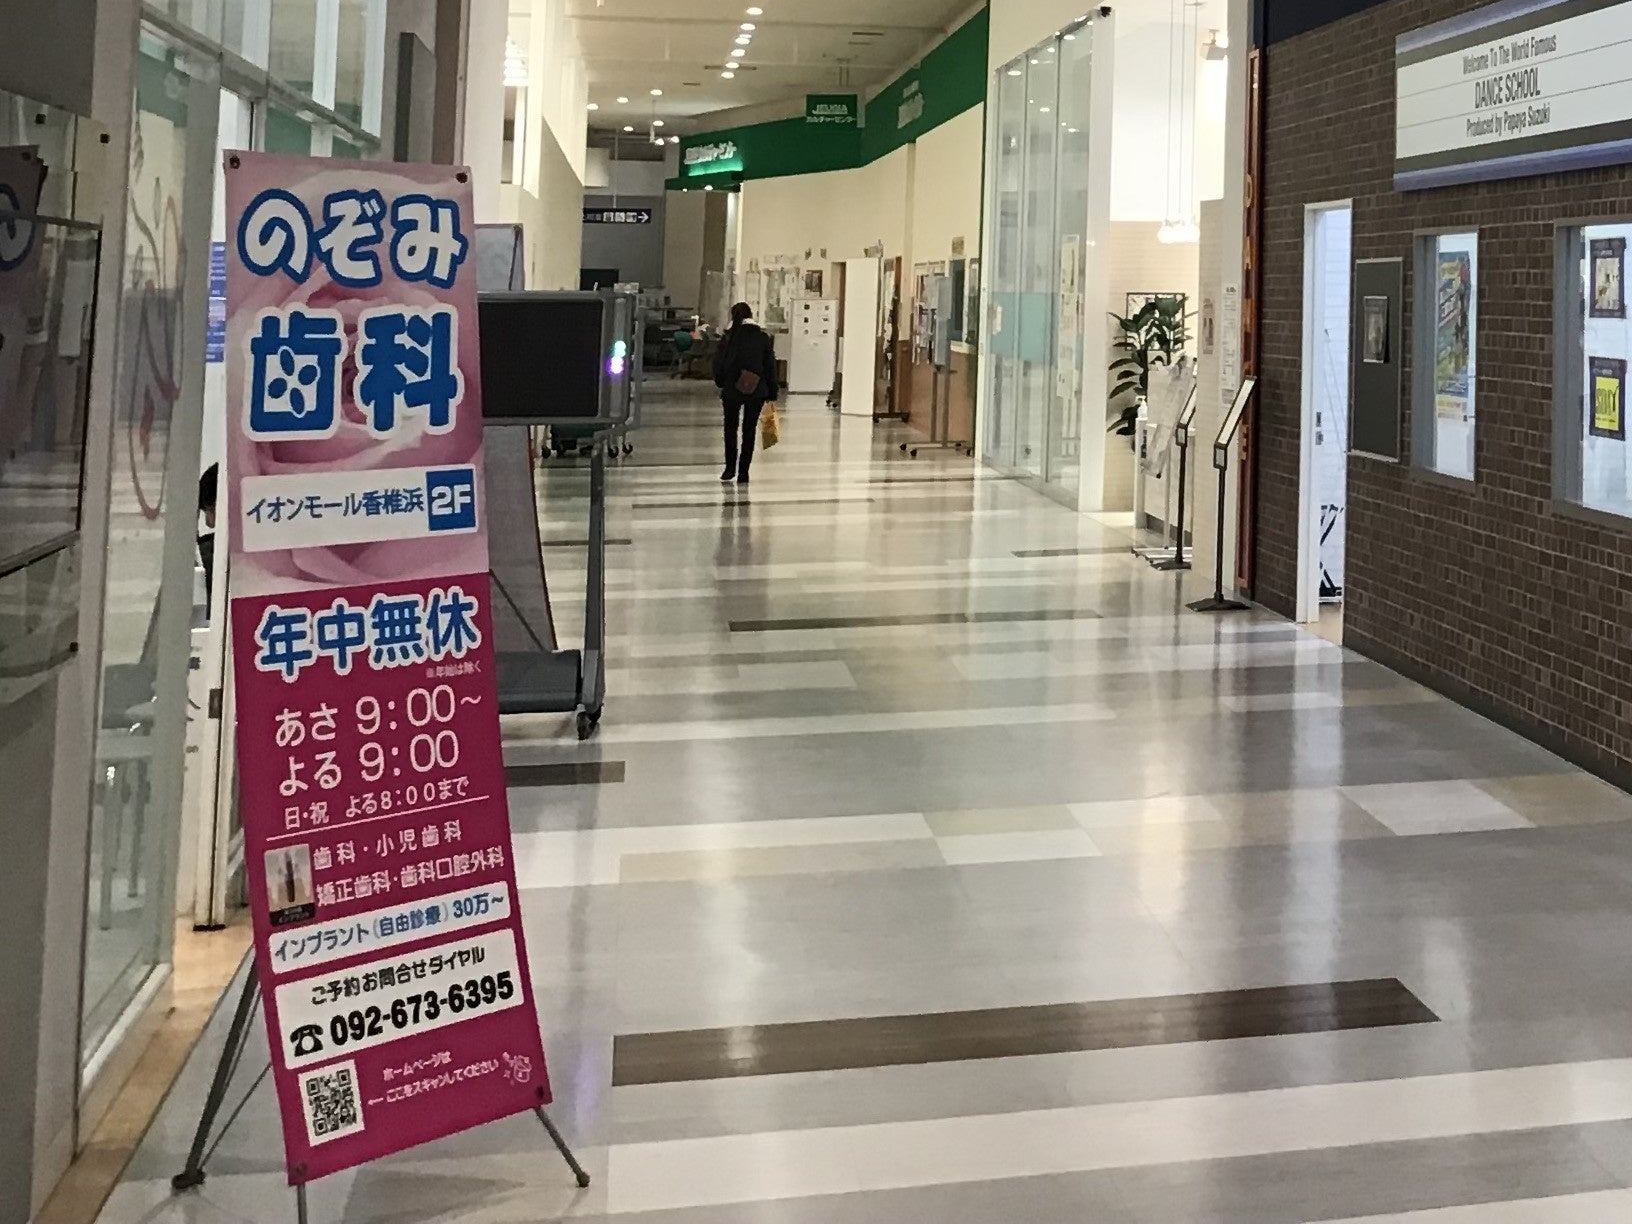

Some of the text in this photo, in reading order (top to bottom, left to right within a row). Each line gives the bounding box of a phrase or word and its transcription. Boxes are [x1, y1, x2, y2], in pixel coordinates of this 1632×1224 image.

[1490, 47, 1498, 67] To
[1498, 45, 1510, 65] The
[1474, 67, 1541, 109] DANCE SCHOOL
[1494, 112, 1503, 137] by
[238, 189, 470, 291] のぞみ
[249, 309, 460, 434] 歯科
[246, 482, 472, 525] イオンモール香椎浜 2F
[254, 586, 482, 683] 年中無休
[275, 702, 339, 747] あさ
[279, 729, 459, 796] よる 9:00
[310, 945, 486, 1005] ご予約お問合せダイヤル
[329, 970, 515, 1047] 092-673-6395
